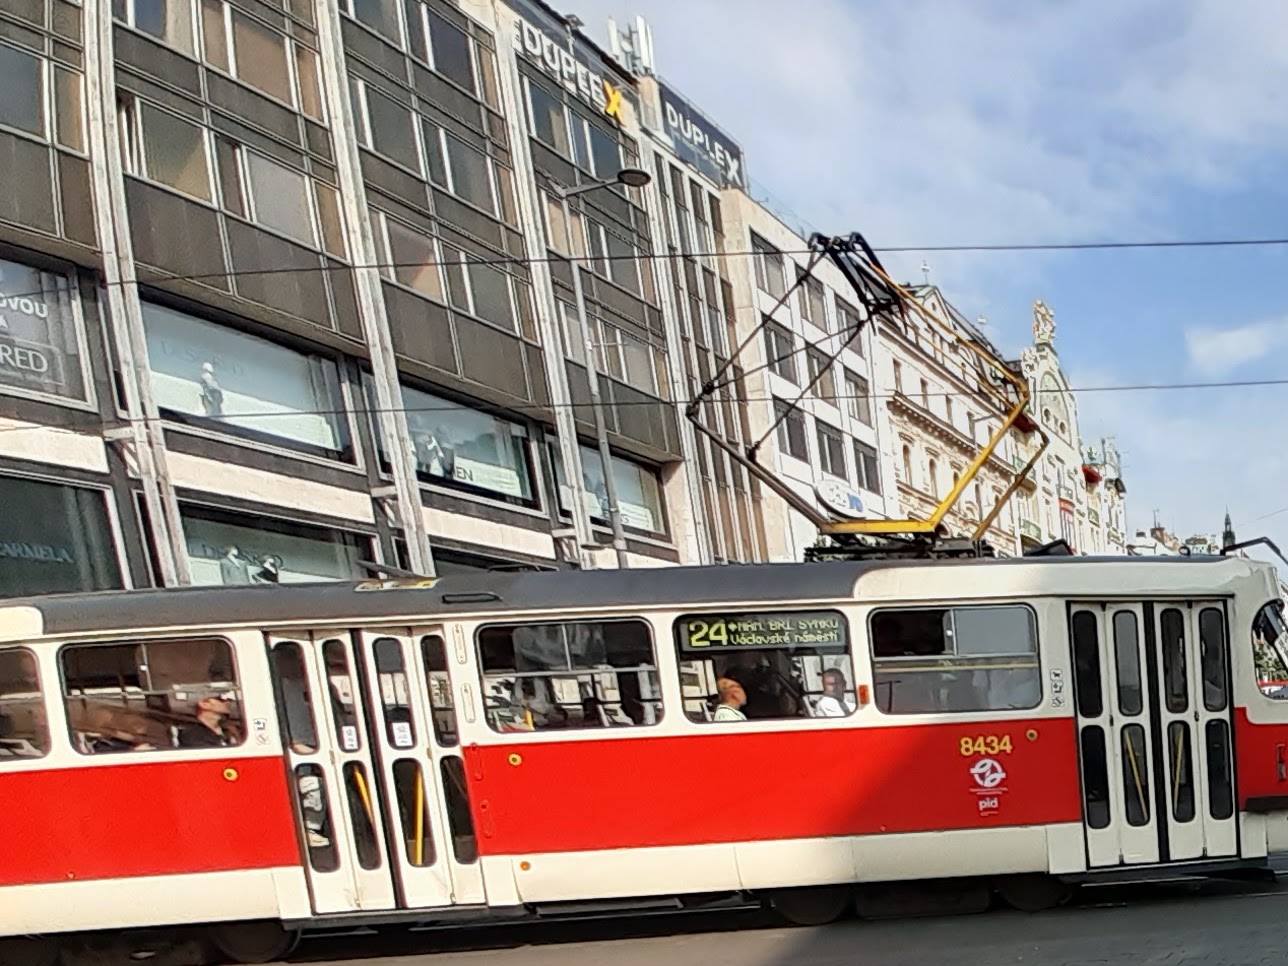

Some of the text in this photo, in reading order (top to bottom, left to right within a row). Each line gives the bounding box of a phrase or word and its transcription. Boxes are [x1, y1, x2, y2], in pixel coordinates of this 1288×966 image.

[519, 19, 626, 127] DUPLEX
[664, 101, 743, 187] DUPLEX
[690, 620, 728, 648] 24
[960, 734, 1014, 756] 8434
[978, 797, 999, 811] pid
